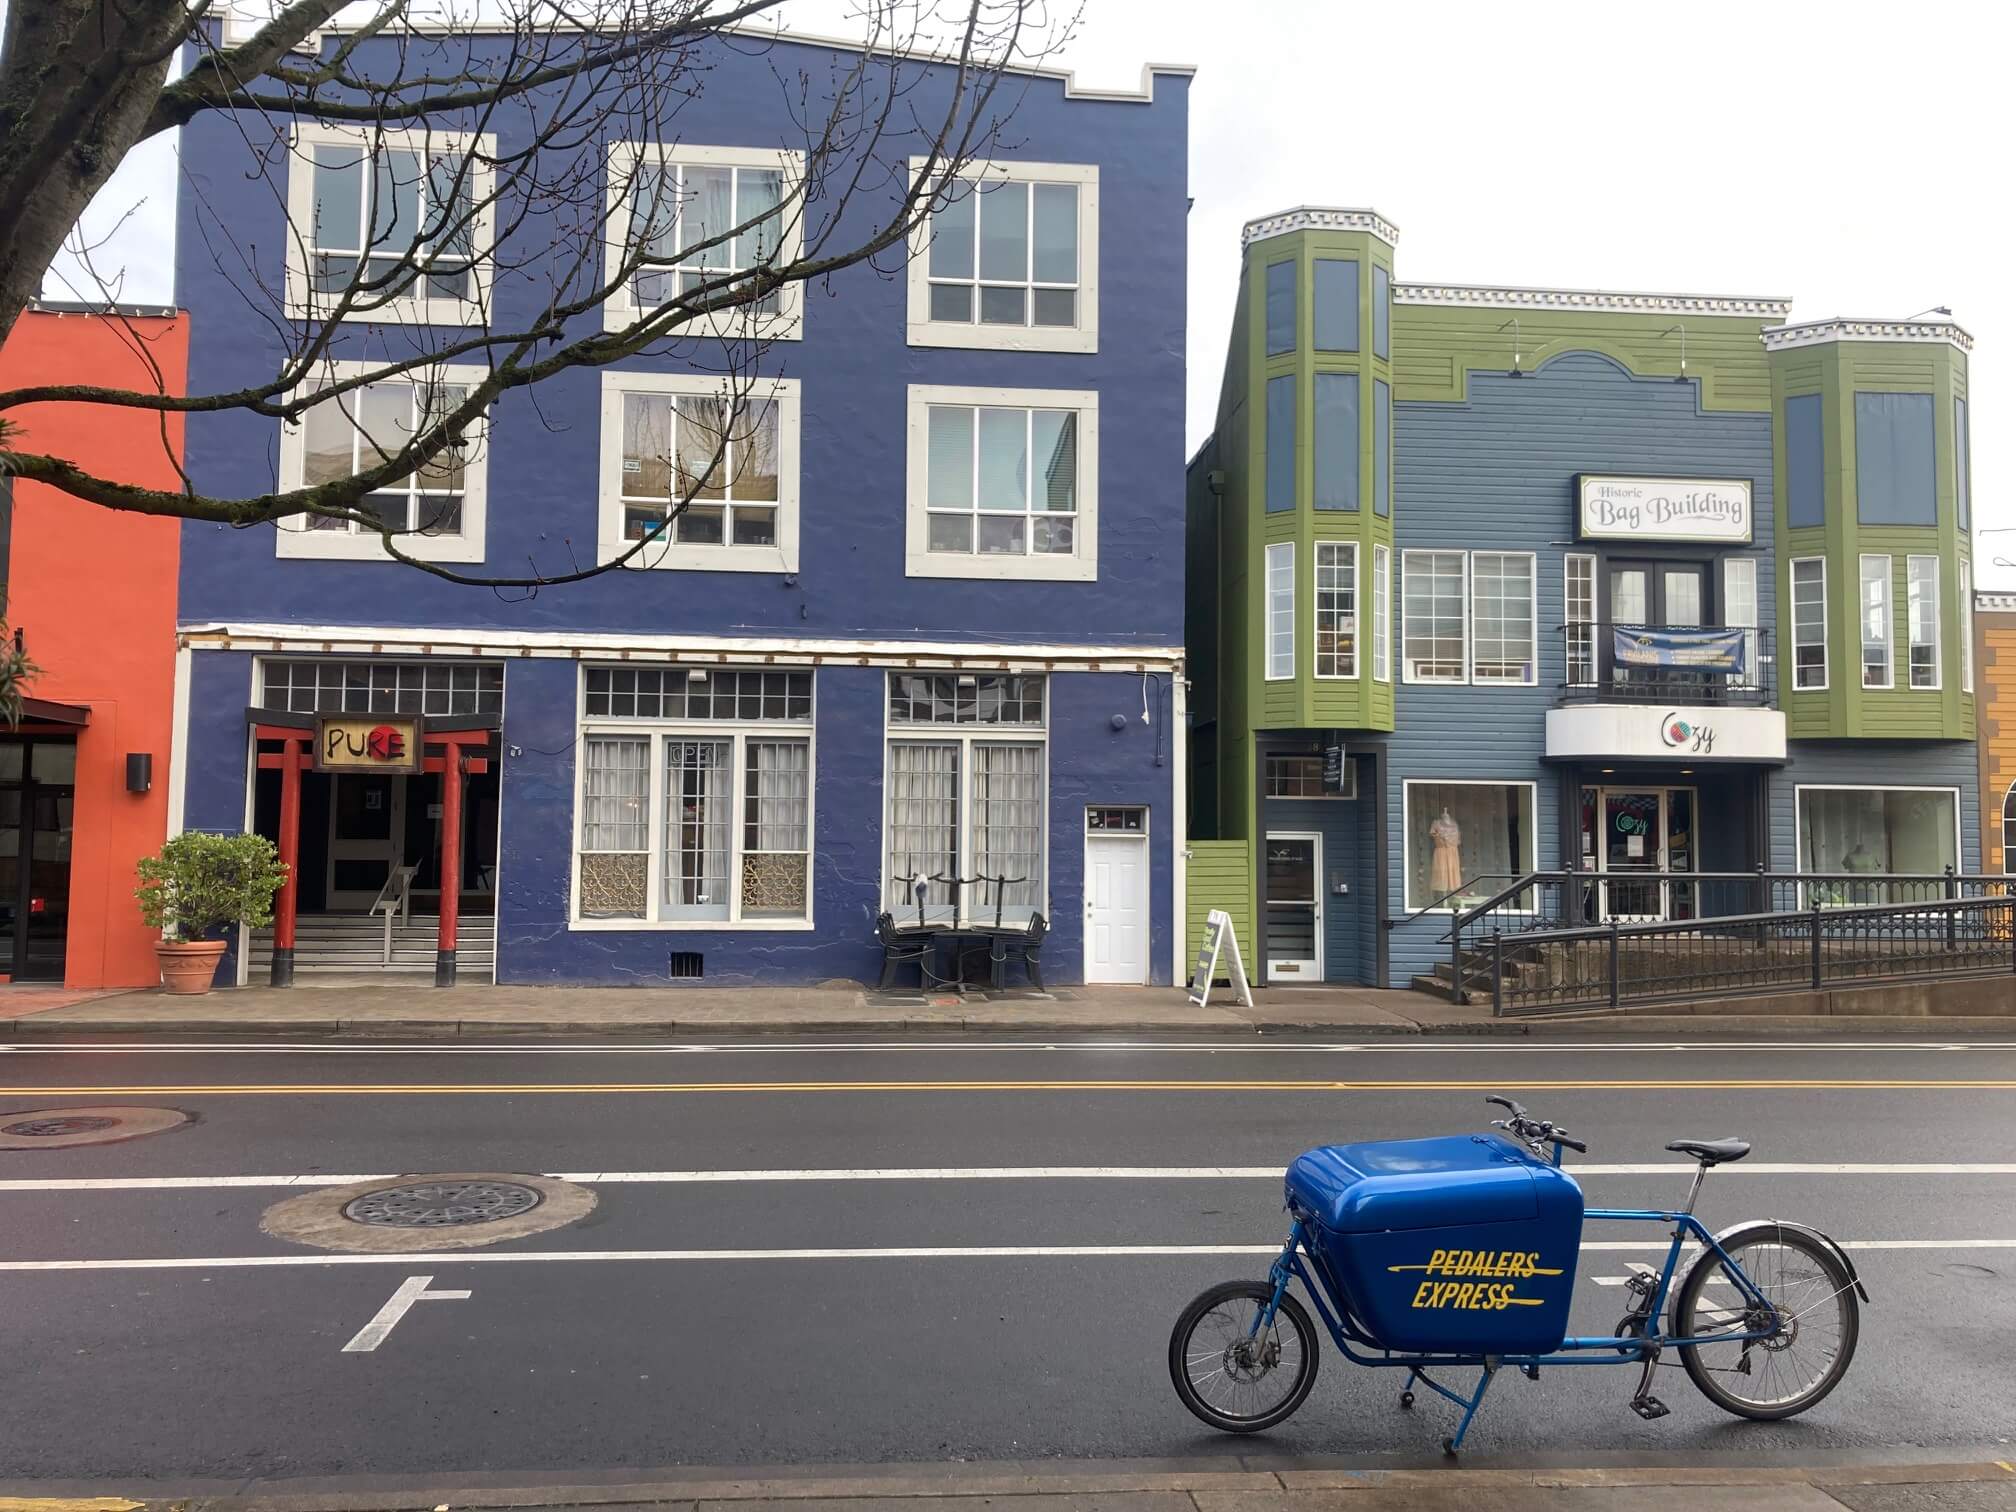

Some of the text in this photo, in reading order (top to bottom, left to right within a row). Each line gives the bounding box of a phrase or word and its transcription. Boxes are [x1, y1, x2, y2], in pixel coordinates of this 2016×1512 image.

[1599, 486, 1643, 498] Historic
[1590, 492, 1742, 529] Bag Building
[1426, 1249, 1541, 1278] PEDALERS
[1411, 1281, 1517, 1310] EXPRESS
